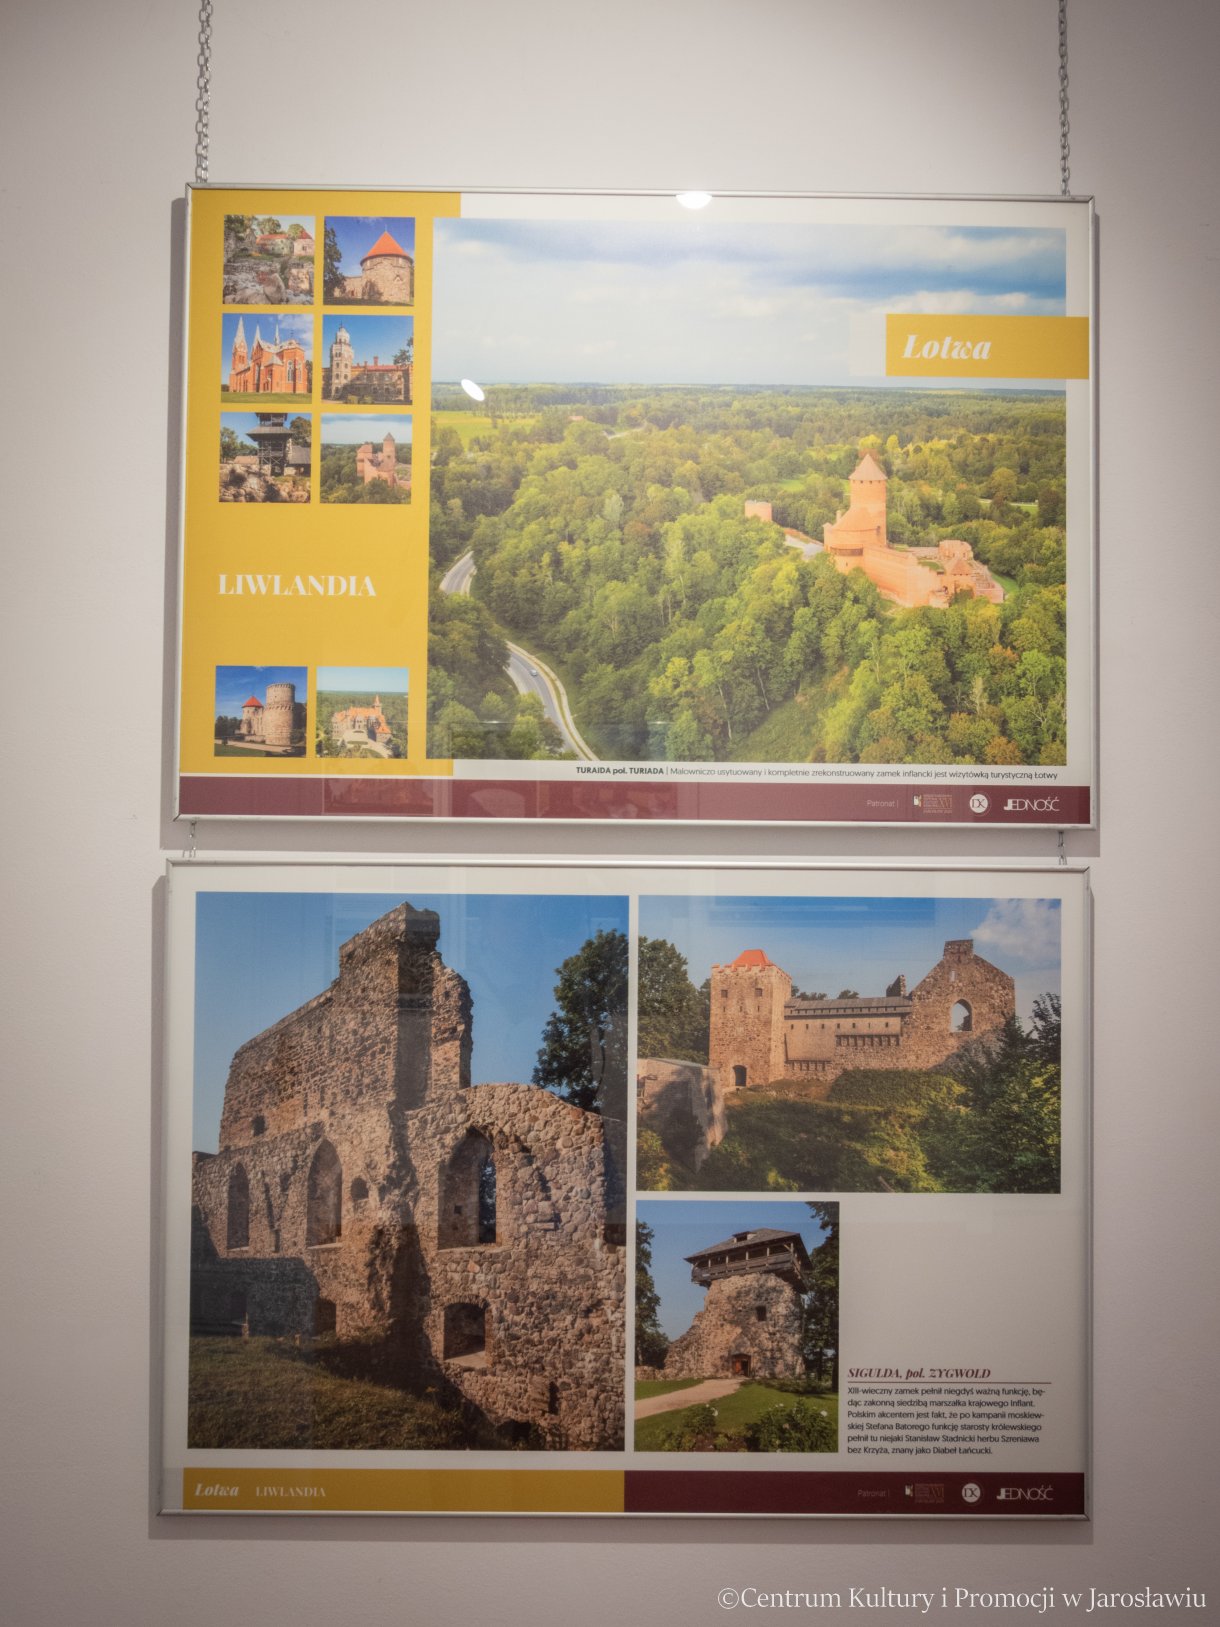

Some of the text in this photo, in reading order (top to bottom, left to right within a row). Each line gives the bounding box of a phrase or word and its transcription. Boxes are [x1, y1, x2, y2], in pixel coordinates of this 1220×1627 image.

[218, 573, 377, 597] LIWLANDIA
[576, 766, 611, 775] TURAIDA
[612, 767, 627, 776] pol.
[629, 767, 664, 776] TURIADA
[670, 767, 716, 776] Malowniczo
[717, 768, 762, 777] usytuowany
[768, 768, 810, 777] kompletnie
[811, 769, 874, 778] zrekonstruowany
[876, 770, 901, 778] zamek
[902, 770, 933, 778] inflancki
[934, 770, 948, 780] jest
[949, 771, 989, 780] wizytówką
[990, 771, 1033, 781] turystyczną
[866, 799, 896, 809] Patronat
[1003, 796, 1060, 812] JEDNOŚĆ
[847, 1367, 992, 1380] SIGULDA, pol. ZYGWOLD
[847, 1386, 1046, 1398] XIII-wieczny zamek pełnił niegdyś ważną funkcję, bę-
[847, 1399, 1036, 1409] dąc zakonną siedzibą marszałka krajowego Inflant.
[847, 1410, 876, 1419] Polskim
[877, 1411, 915, 1419] akcentem
[915, 1411, 930, 1420] jest
[931, 1411, 948, 1420] fakt,
[948, 1411, 958, 1419] że
[972, 1411, 1006, 1420] kampanii
[1007, 1412, 1045, 1420] moskiew-
[847, 1422, 1042, 1432] skiej Stefana Batorego funkcję starosty królewskiego
[847, 1434, 1040, 1443] pełnił tu niejaki Stanisław Stadnicki herbu Szreniawa
[847, 1446, 993, 1456] bez Krzyża, znany jako Diabeł Łańcucki.
[255, 1486, 326, 1497] LIWLANDIA
[857, 1490, 886, 1498] Patronat
